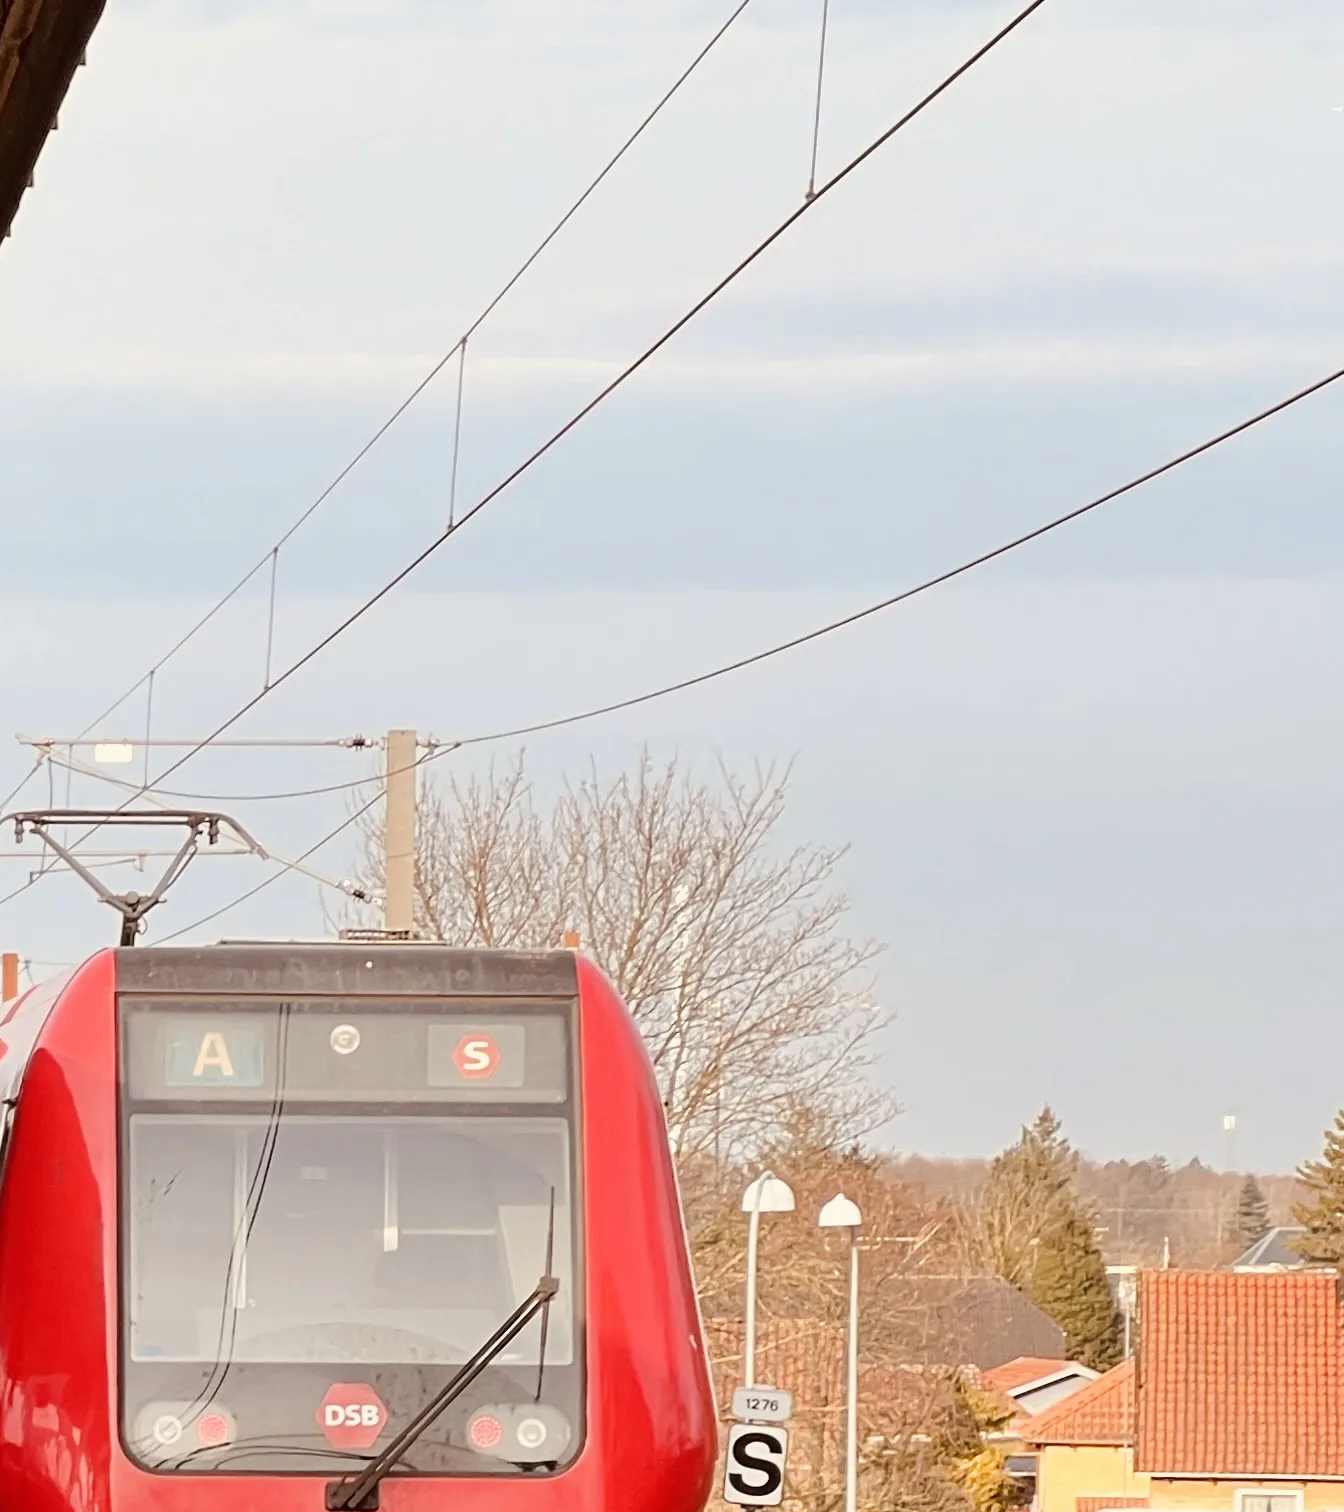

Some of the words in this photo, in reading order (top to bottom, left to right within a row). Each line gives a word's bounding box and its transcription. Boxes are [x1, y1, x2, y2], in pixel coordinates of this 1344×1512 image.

[191, 1032, 234, 1077] A
[463, 1041, 490, 1071] S
[324, 1405, 380, 1427] DSB
[744, 1398, 779, 1413] 1276
[728, 1432, 783, 1497] S
